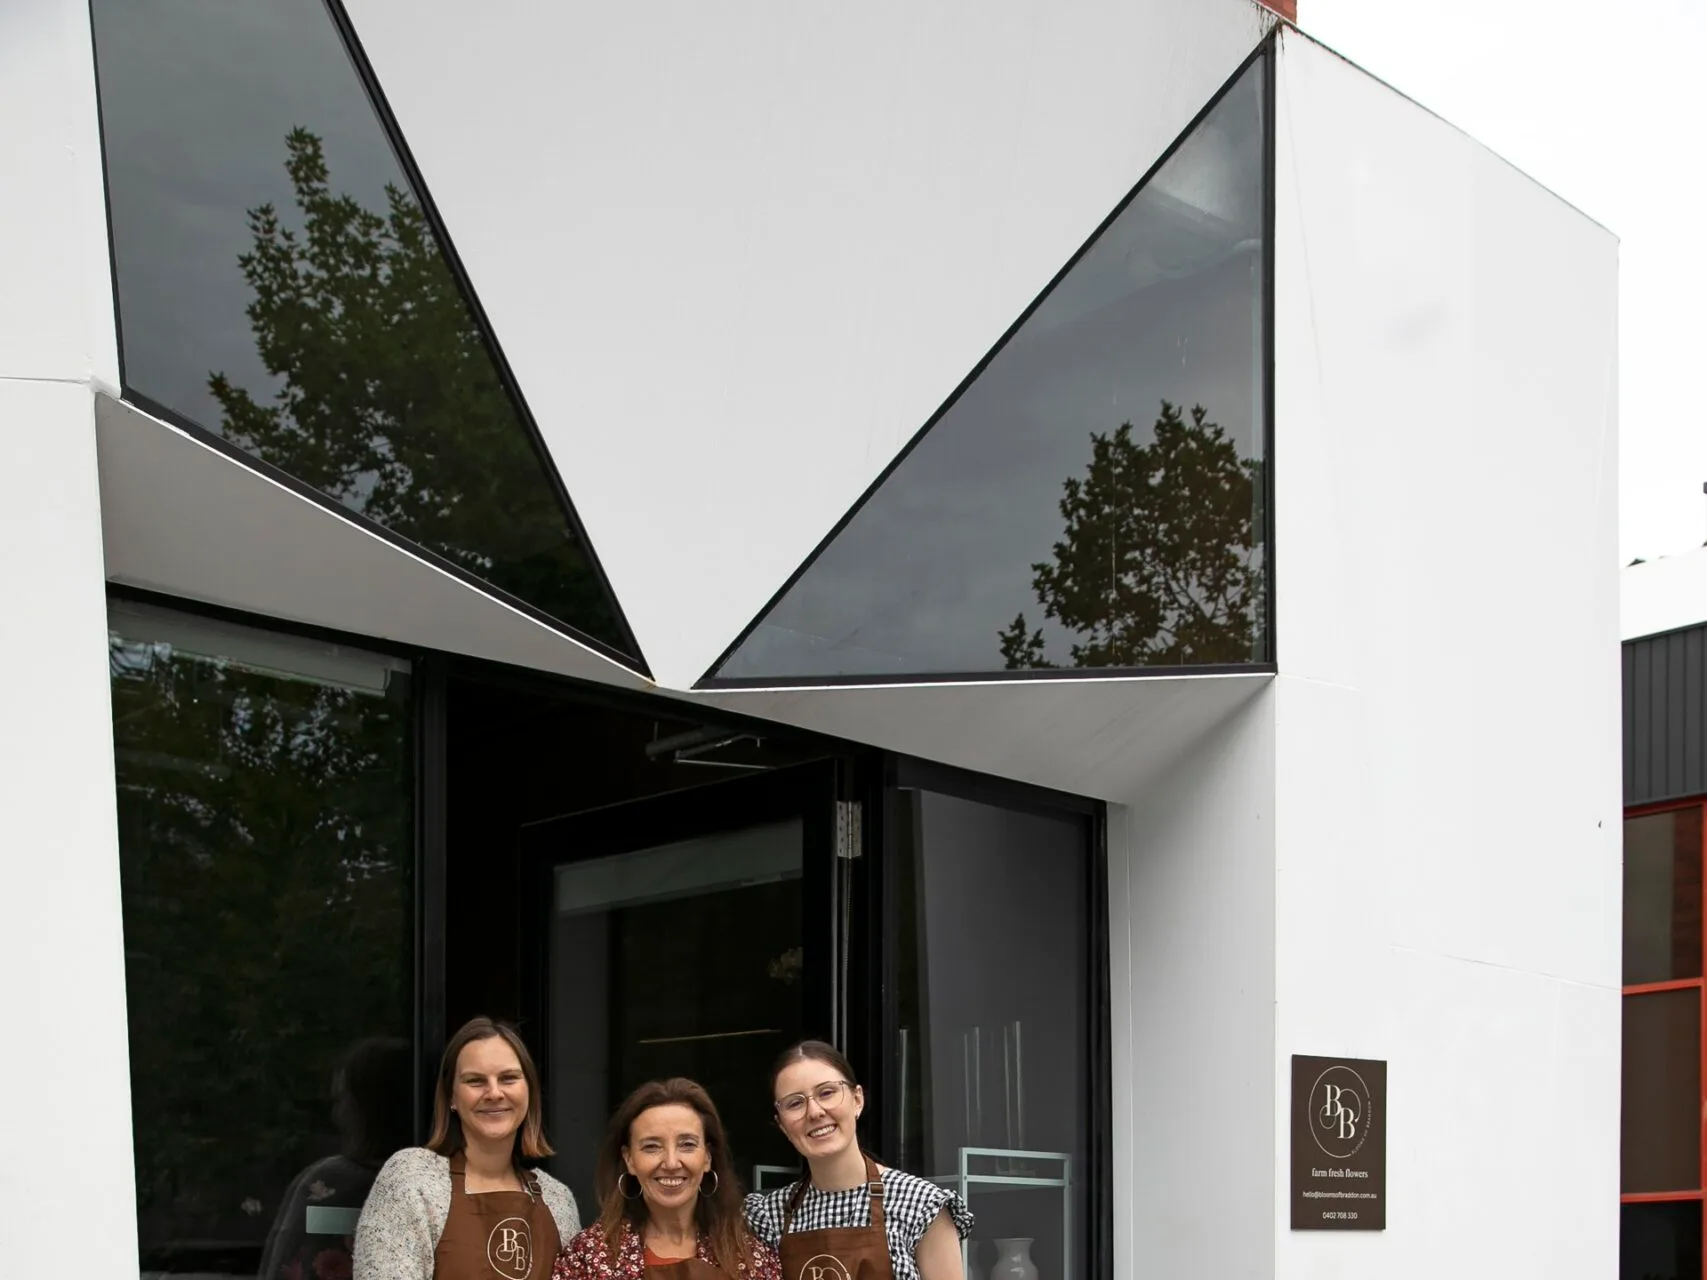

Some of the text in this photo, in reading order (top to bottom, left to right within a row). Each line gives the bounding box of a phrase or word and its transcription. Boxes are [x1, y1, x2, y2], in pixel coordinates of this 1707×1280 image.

[1311, 1168, 1369, 1178] farm fresh flowers
